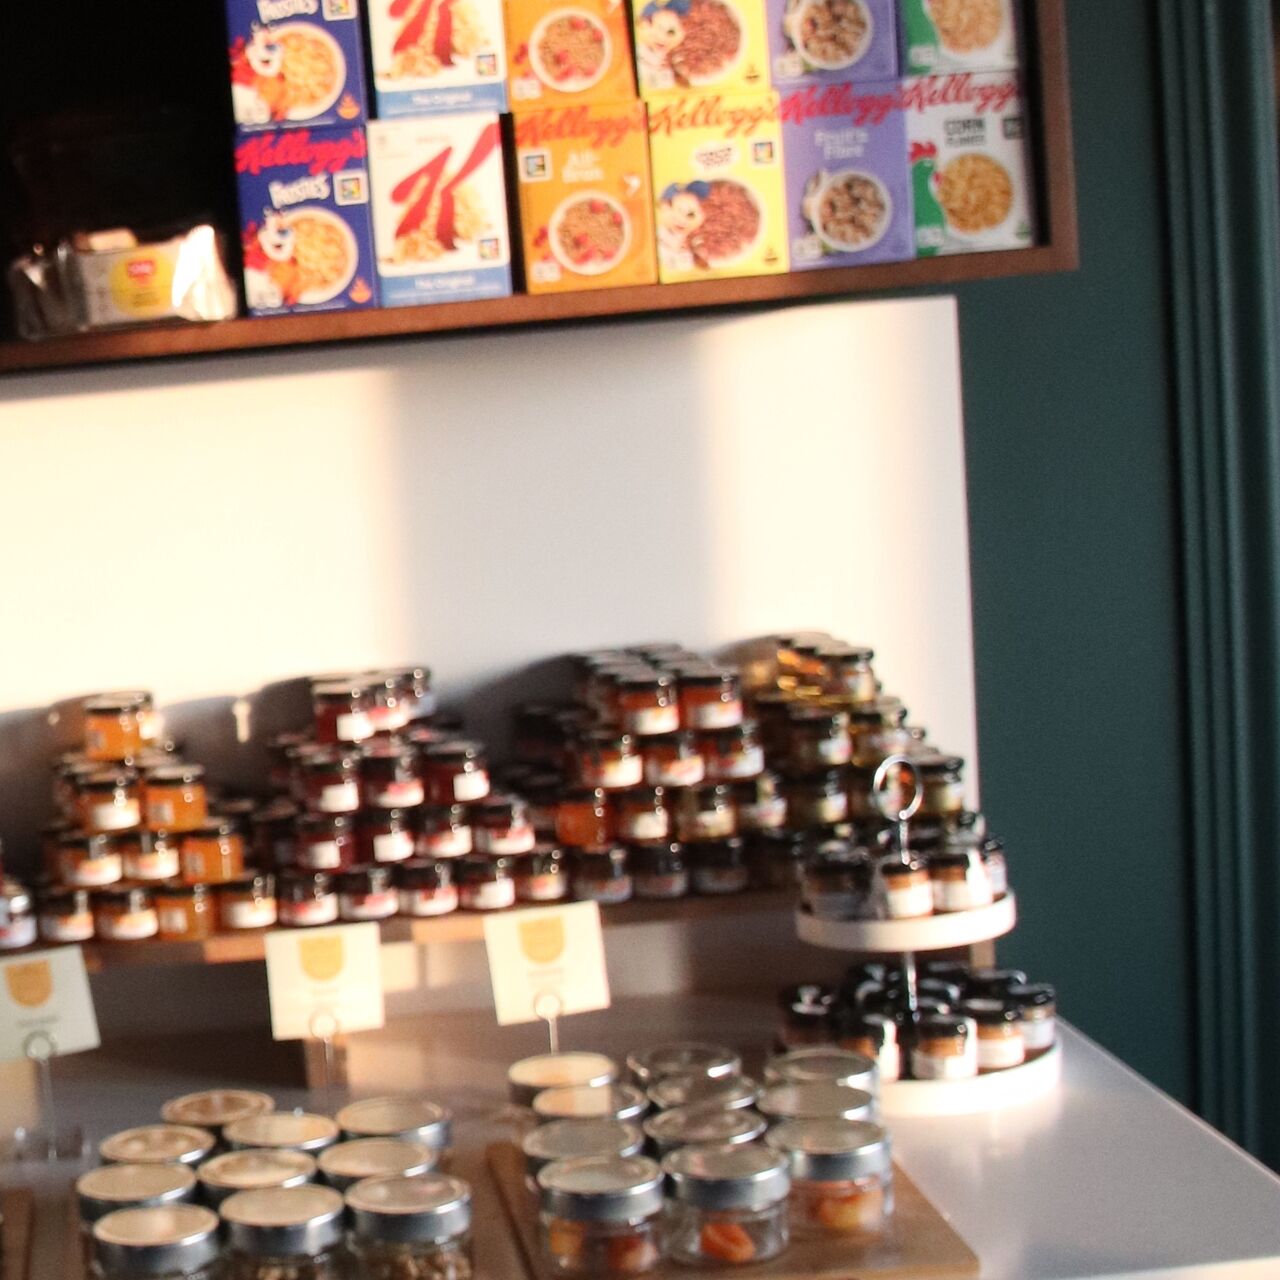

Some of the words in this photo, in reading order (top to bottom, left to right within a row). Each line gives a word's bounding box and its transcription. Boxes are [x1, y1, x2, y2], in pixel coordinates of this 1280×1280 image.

[900, 72, 1018, 115] Kellogg
[648, 95, 778, 138] Kellogg's
[390, 122, 499, 251] K
